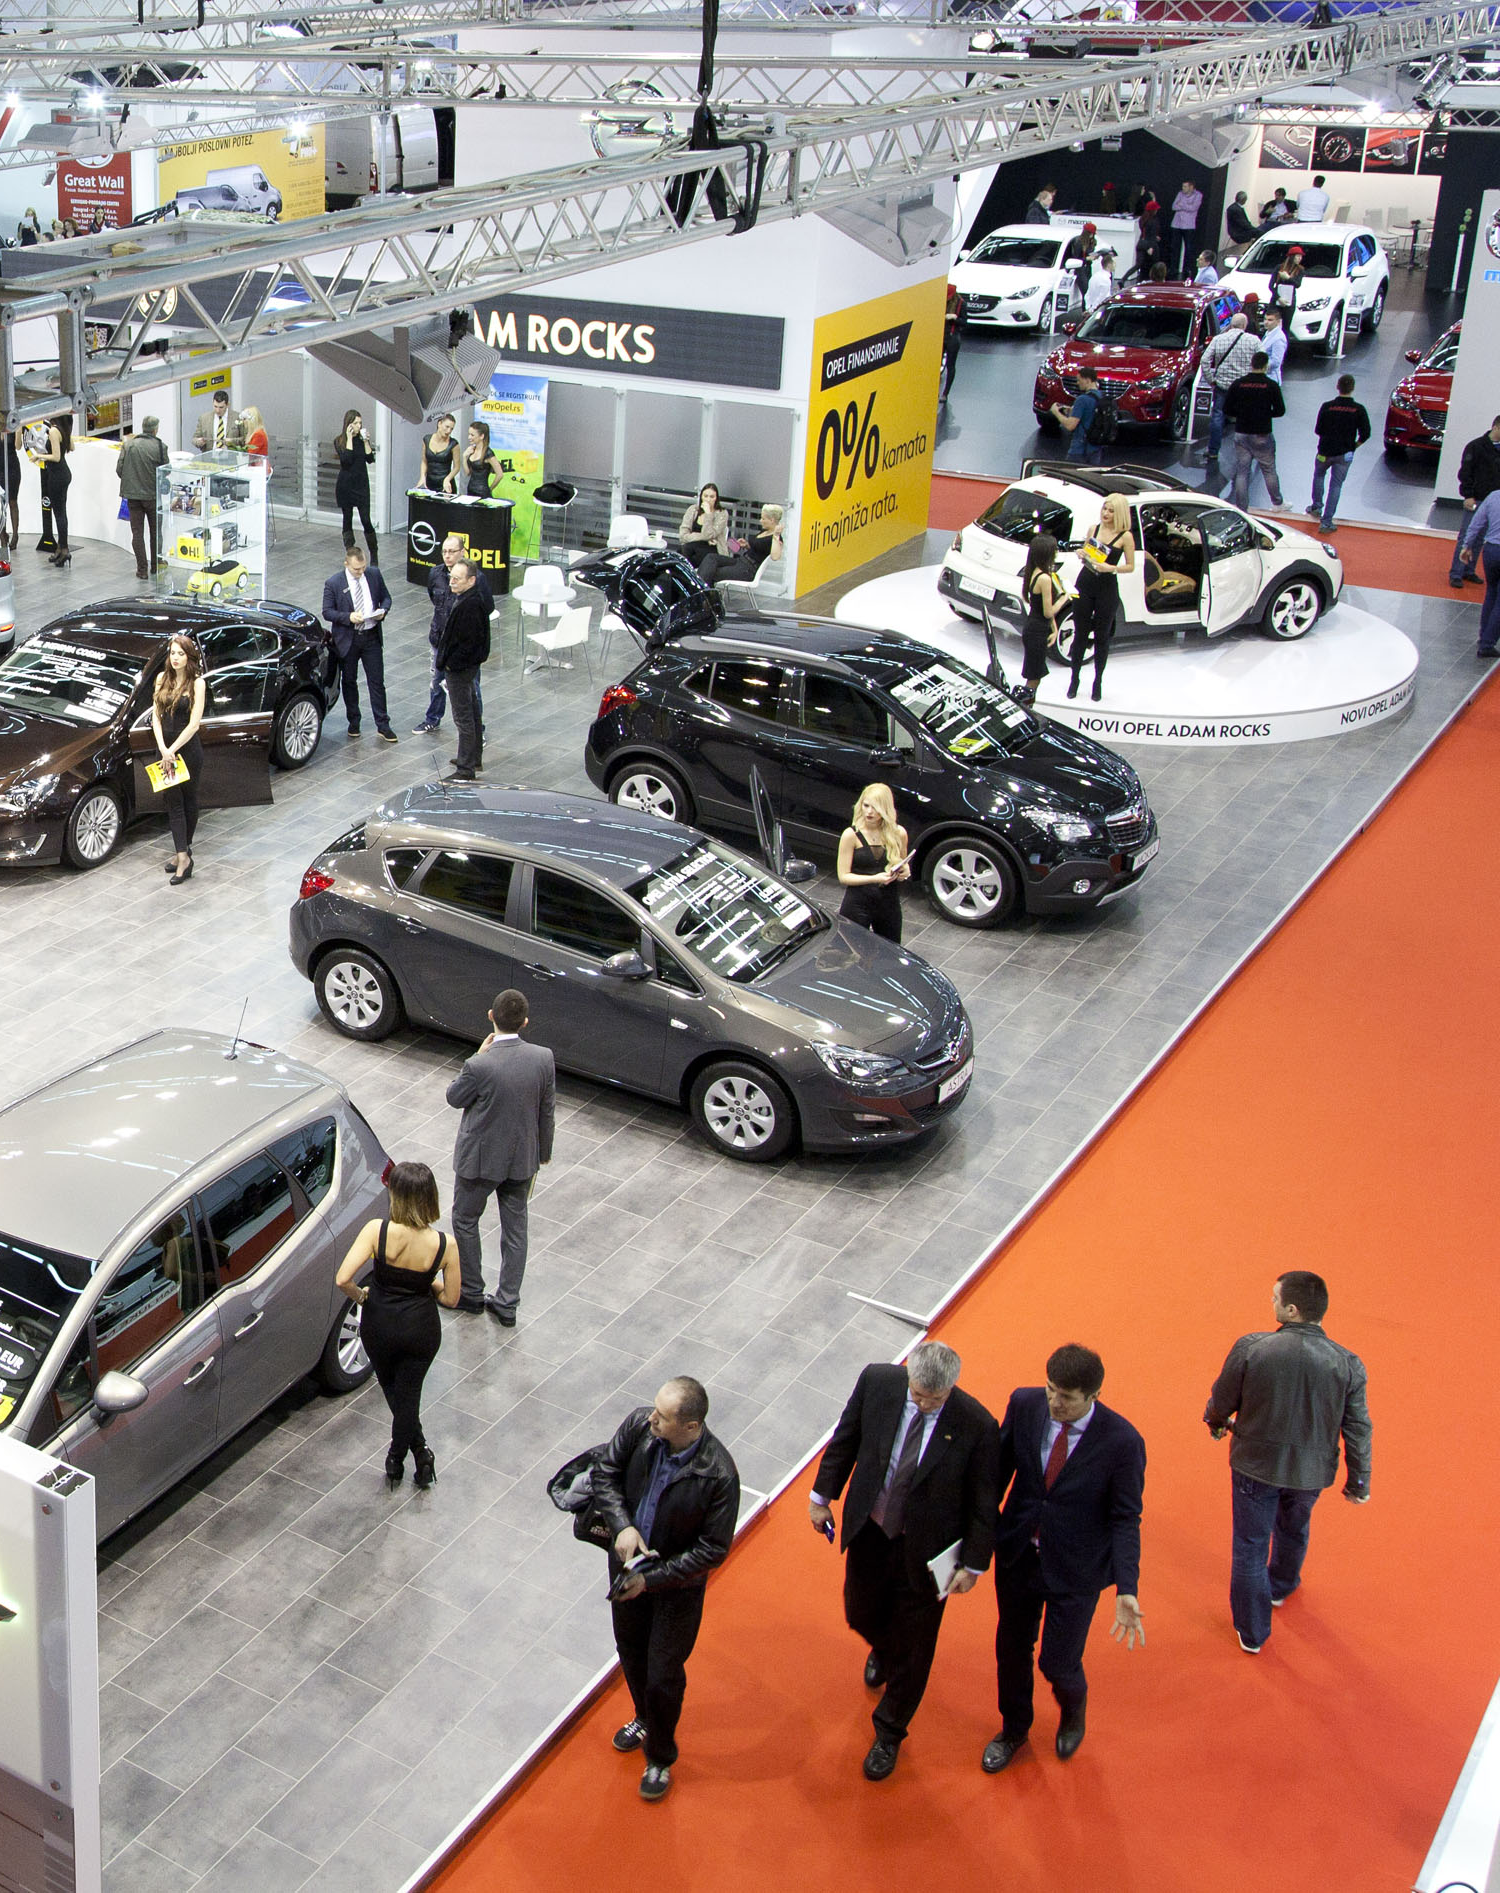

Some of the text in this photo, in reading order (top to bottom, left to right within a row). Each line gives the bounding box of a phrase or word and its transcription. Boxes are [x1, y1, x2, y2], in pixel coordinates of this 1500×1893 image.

[198, 139, 231, 154] POSLOVNI
[64, 174, 124, 189] Great Wall
[527, 313, 655, 364] ROCKS
[826, 336, 900, 379] OPEL FINANSIRANJE
[483, 402, 521, 413] myOpel.rs
[816, 390, 927, 501] 0% kamata
[809, 490, 899, 553] ili najniža rata.
[1340, 706, 1368, 726] NOVI
[1367, 699, 1389, 717] OPEL
[1077, 716, 1271, 739] NOVI OPEL ADAM ROCKS
[0, 1349, 25, 1370] EUR
